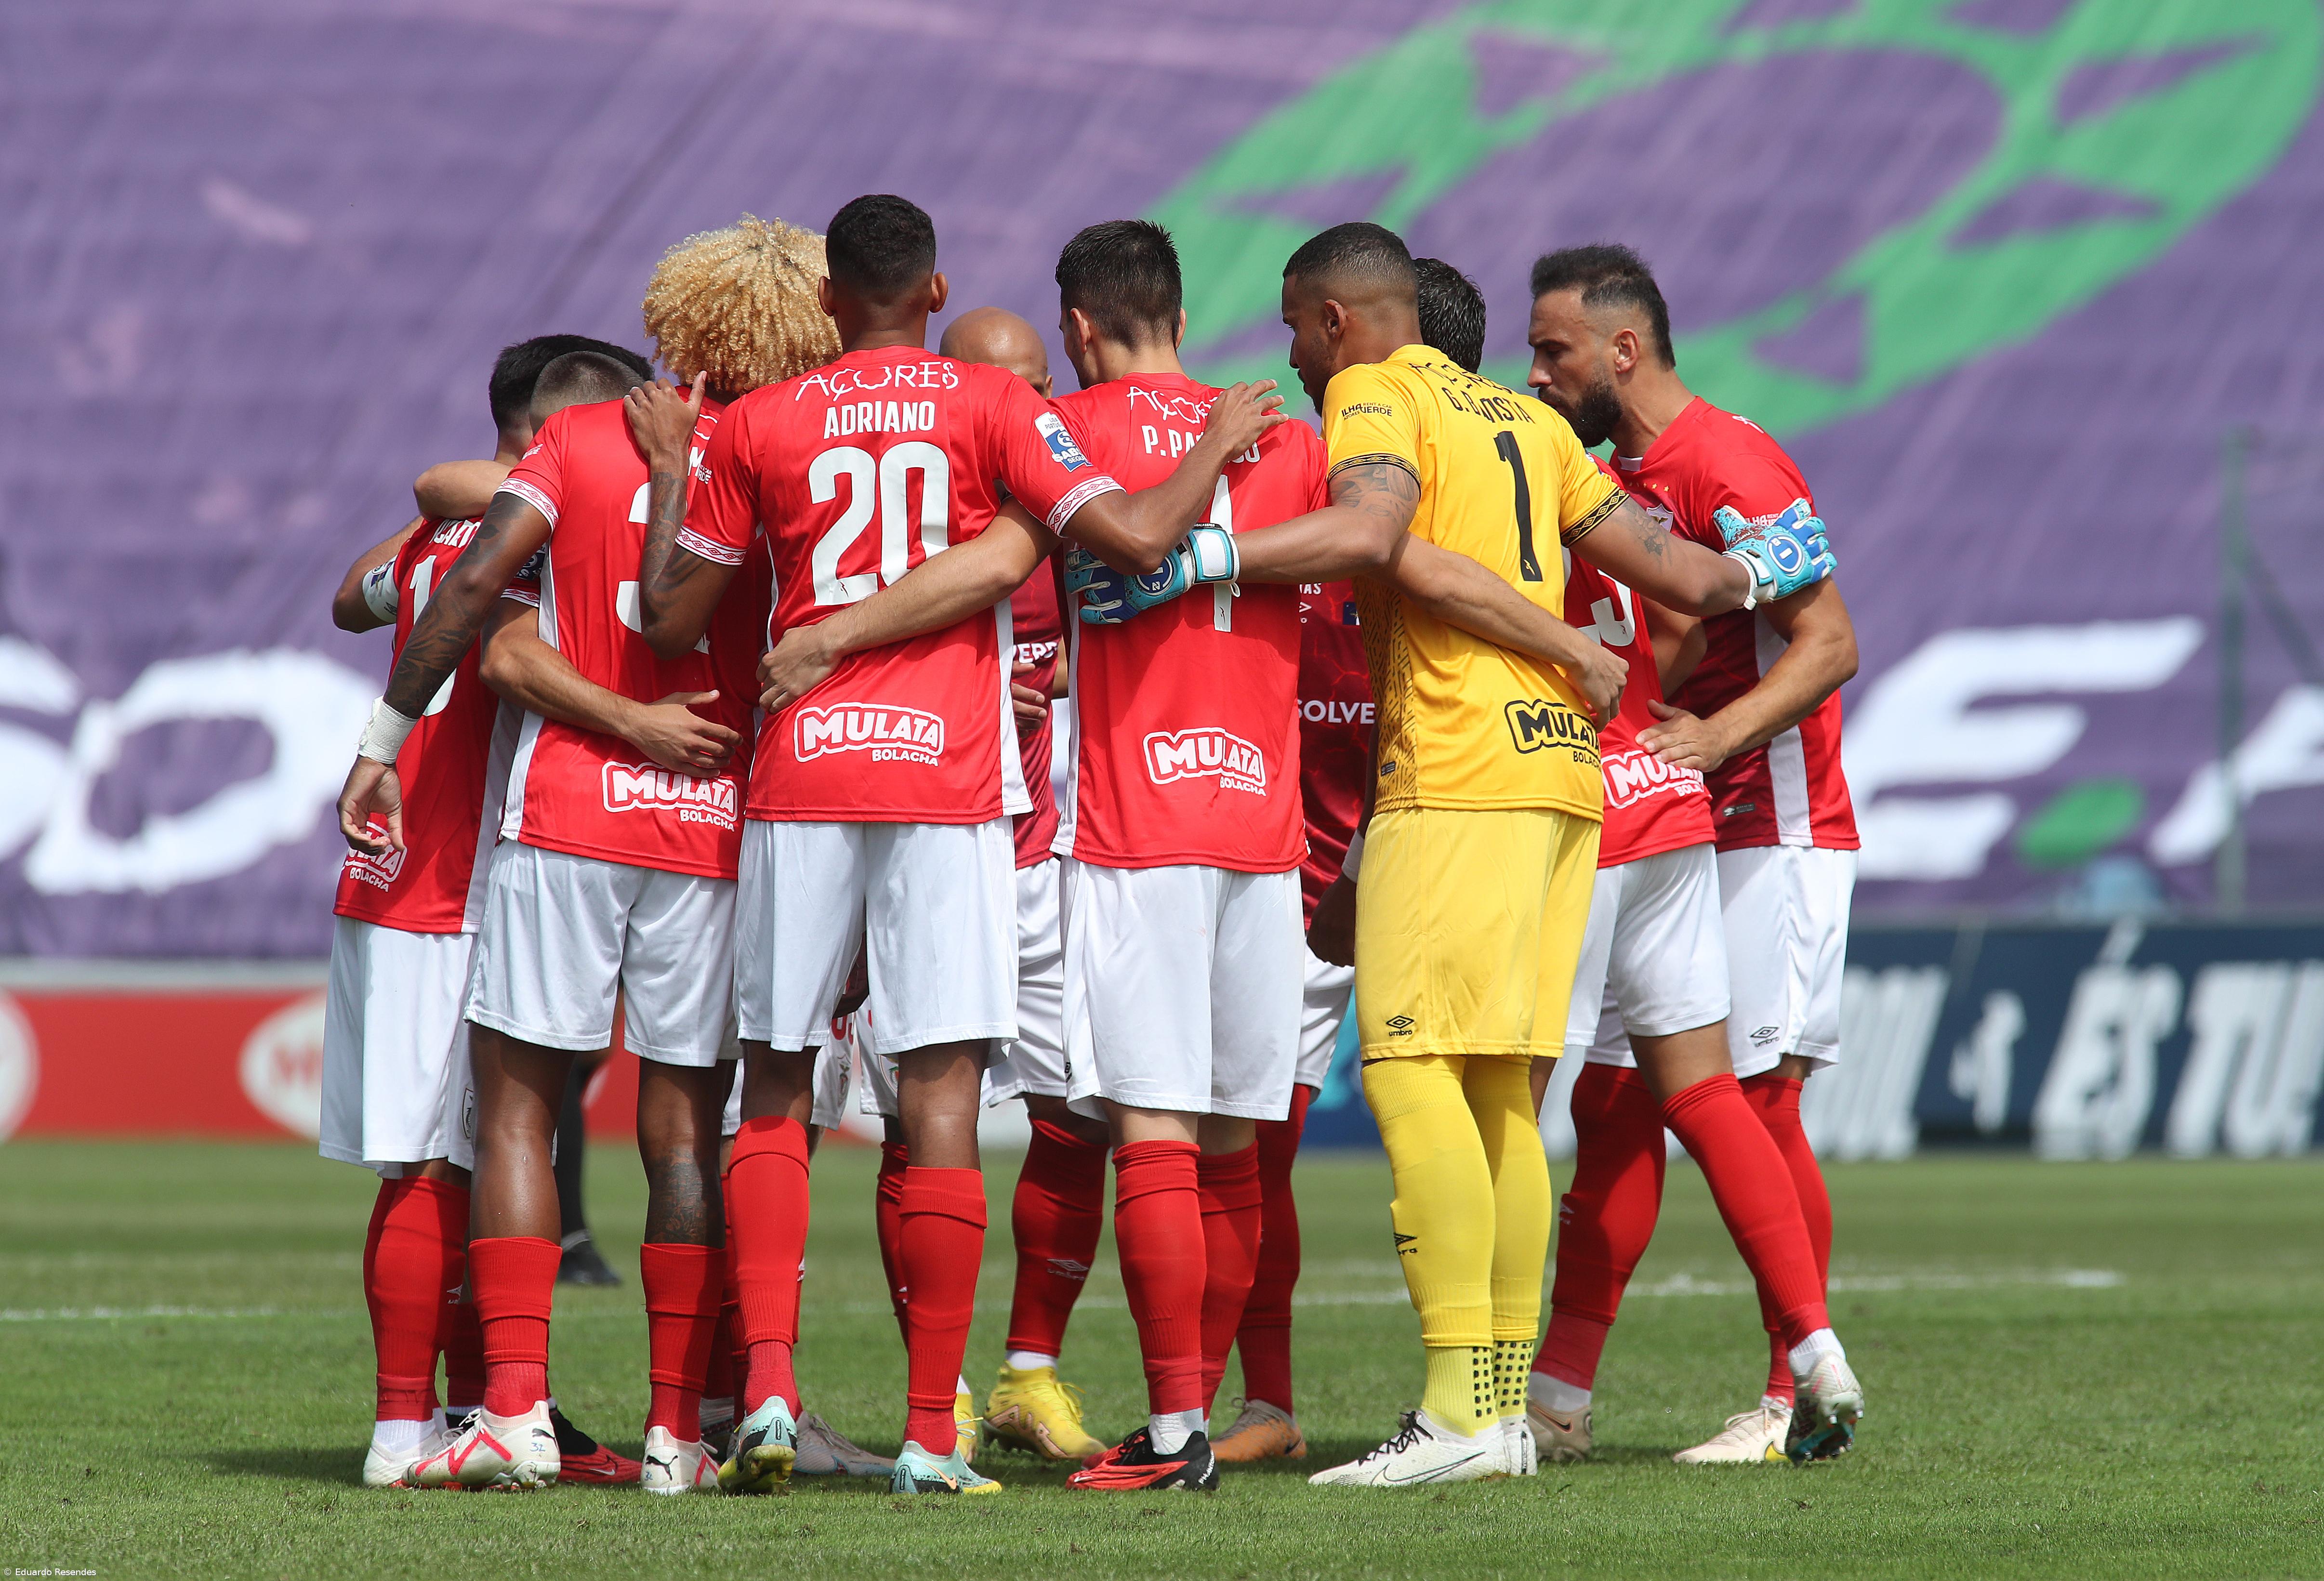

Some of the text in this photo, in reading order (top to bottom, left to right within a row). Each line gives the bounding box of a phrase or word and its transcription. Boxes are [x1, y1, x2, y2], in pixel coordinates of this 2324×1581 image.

[794, 361, 959, 401] AÇORES
[823, 401, 935, 439] ADRIANO
[1342, 404, 1392, 417] ILHA VERDE
[1493, 432, 1543, 582] 1
[808, 441, 950, 606] 20
[802, 711, 939, 751] MULATA
[872, 748, 938, 767] BOLACHA
[1153, 736, 1261, 779] MULATA
[612, 770, 734, 814] MULATA
[1219, 776, 1266, 797] BOLACHA
[680, 809, 735, 832] BOLACHA
[349, 867, 389, 893] BOLACHA
[1754, 1036, 1780, 1047] umbro
[529, 1442, 545, 1452] 32
